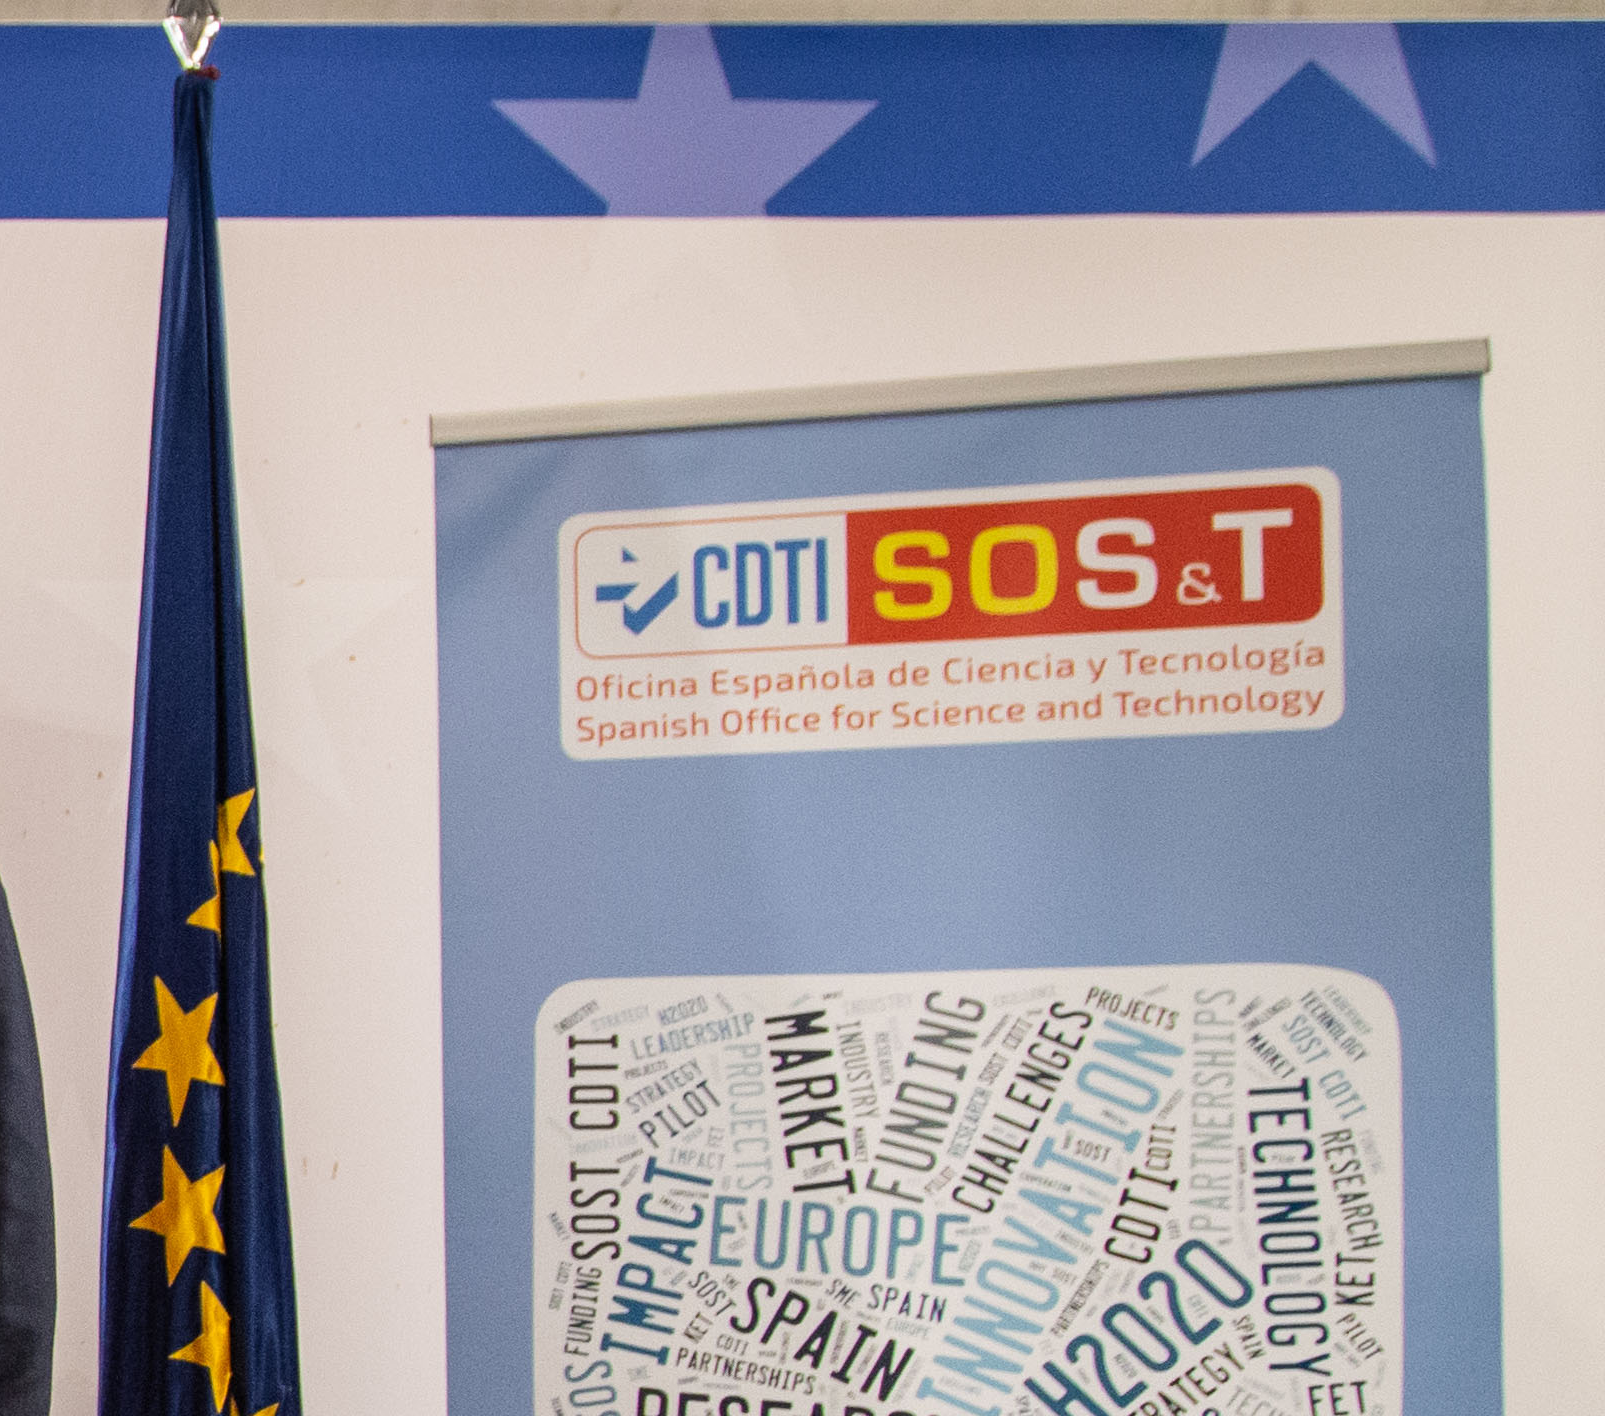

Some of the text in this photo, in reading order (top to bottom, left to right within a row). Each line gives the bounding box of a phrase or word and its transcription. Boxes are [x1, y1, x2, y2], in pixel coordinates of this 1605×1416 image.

[692, 537, 830, 630] CDTI
[576, 640, 1324, 702] Oficina Española de Ciencia y Tecnología
[576, 686, 1325, 747] Spanish Office for Science and Technology
[568, 1033, 622, 1261] SOST CDTI
[765, 1009, 857, 1194] MARKET
[866, 991, 986, 1204] FUNDING
[952, 1000, 1094, 1215] CHALLENGES
[600, 1155, 714, 1365] IMPACT
[709, 1195, 971, 1287] EUROPE
[1104, 1166, 1179, 1265] CDTI
[1248, 1077, 1332, 1377] TECHNOLOGY
[1335, 1251, 1377, 1309] KET
[1336, 1312, 1384, 1361] PILOT
[729, 1276, 914, 1403] SPAIN
